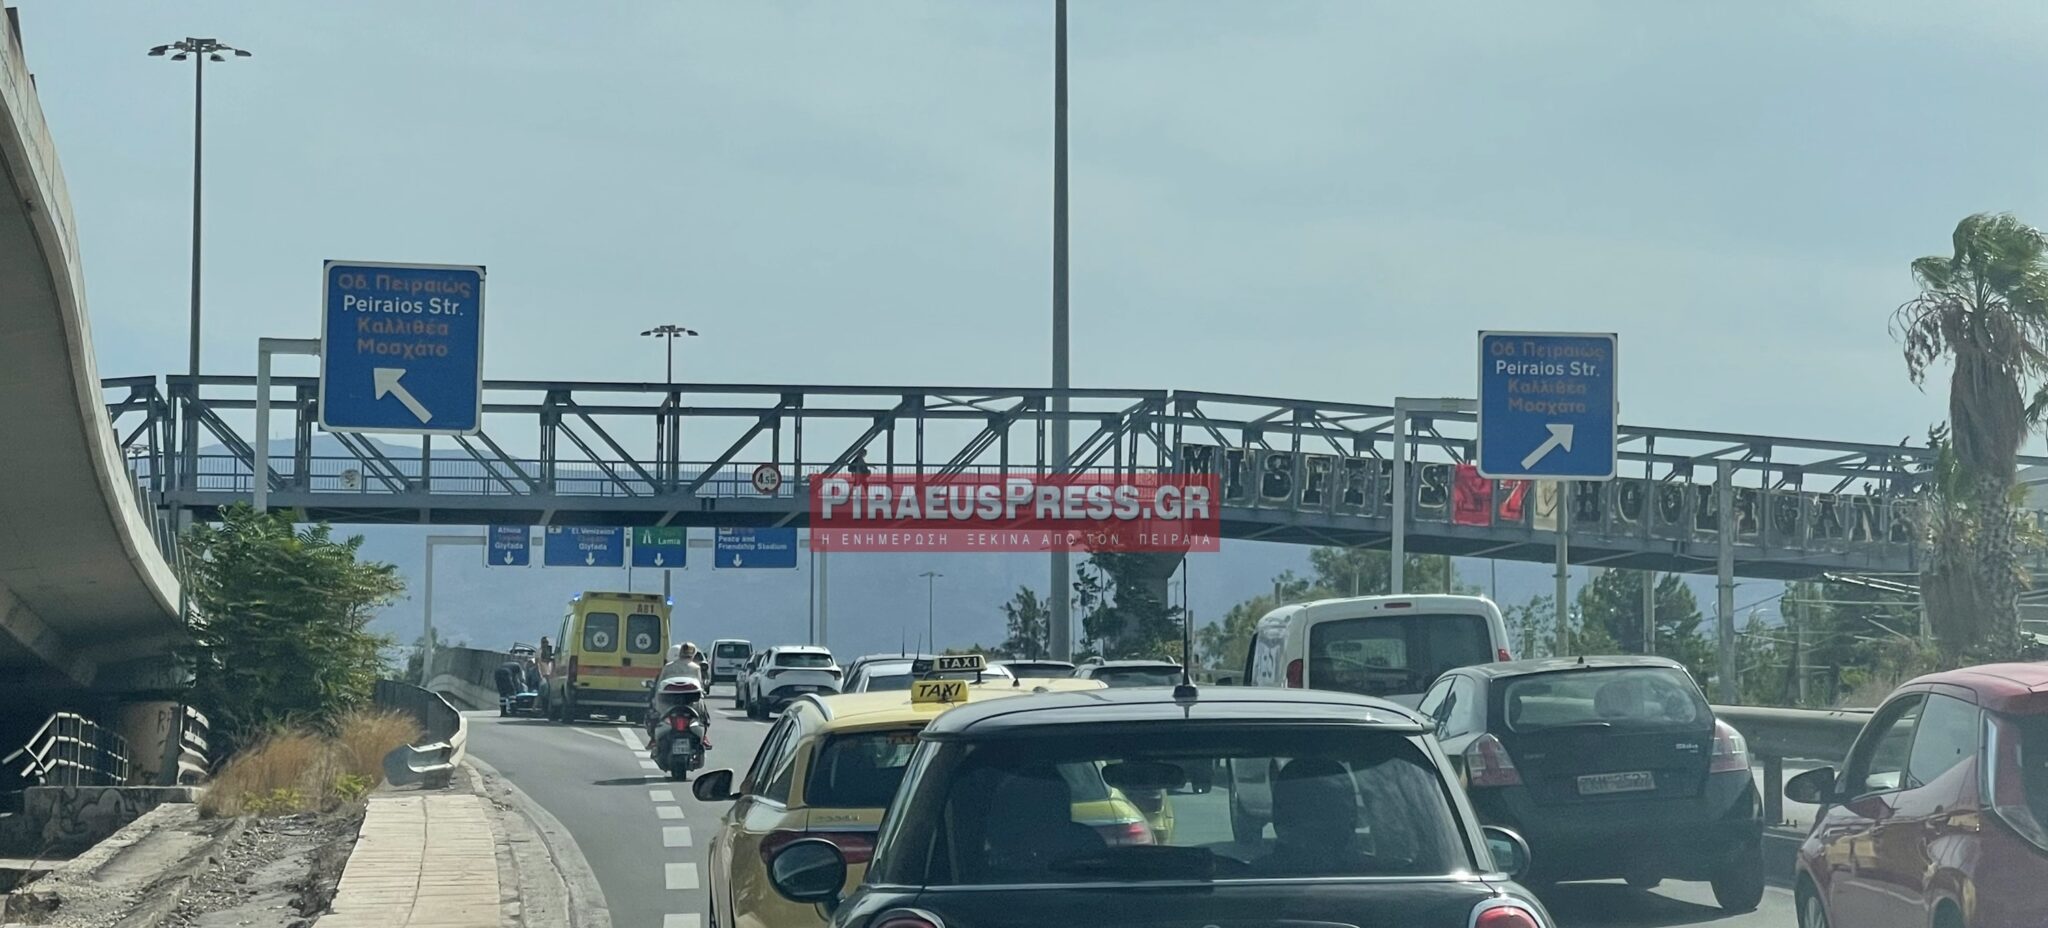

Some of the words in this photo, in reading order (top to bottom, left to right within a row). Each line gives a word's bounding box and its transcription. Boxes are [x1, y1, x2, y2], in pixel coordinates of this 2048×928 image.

[376, 274, 471, 298] Πειραιώς
[343, 295, 423, 314] Peiraios
[428, 297, 464, 317] Str.
[357, 317, 449, 336] Καλλιθέα
[357, 338, 449, 360] Μοσχάτο
[1496, 360, 1565, 376] Peiraios
[1569, 361, 1600, 377] Str.
[941, 657, 978, 668] TAXI
[918, 682, 962, 698] TAXI
